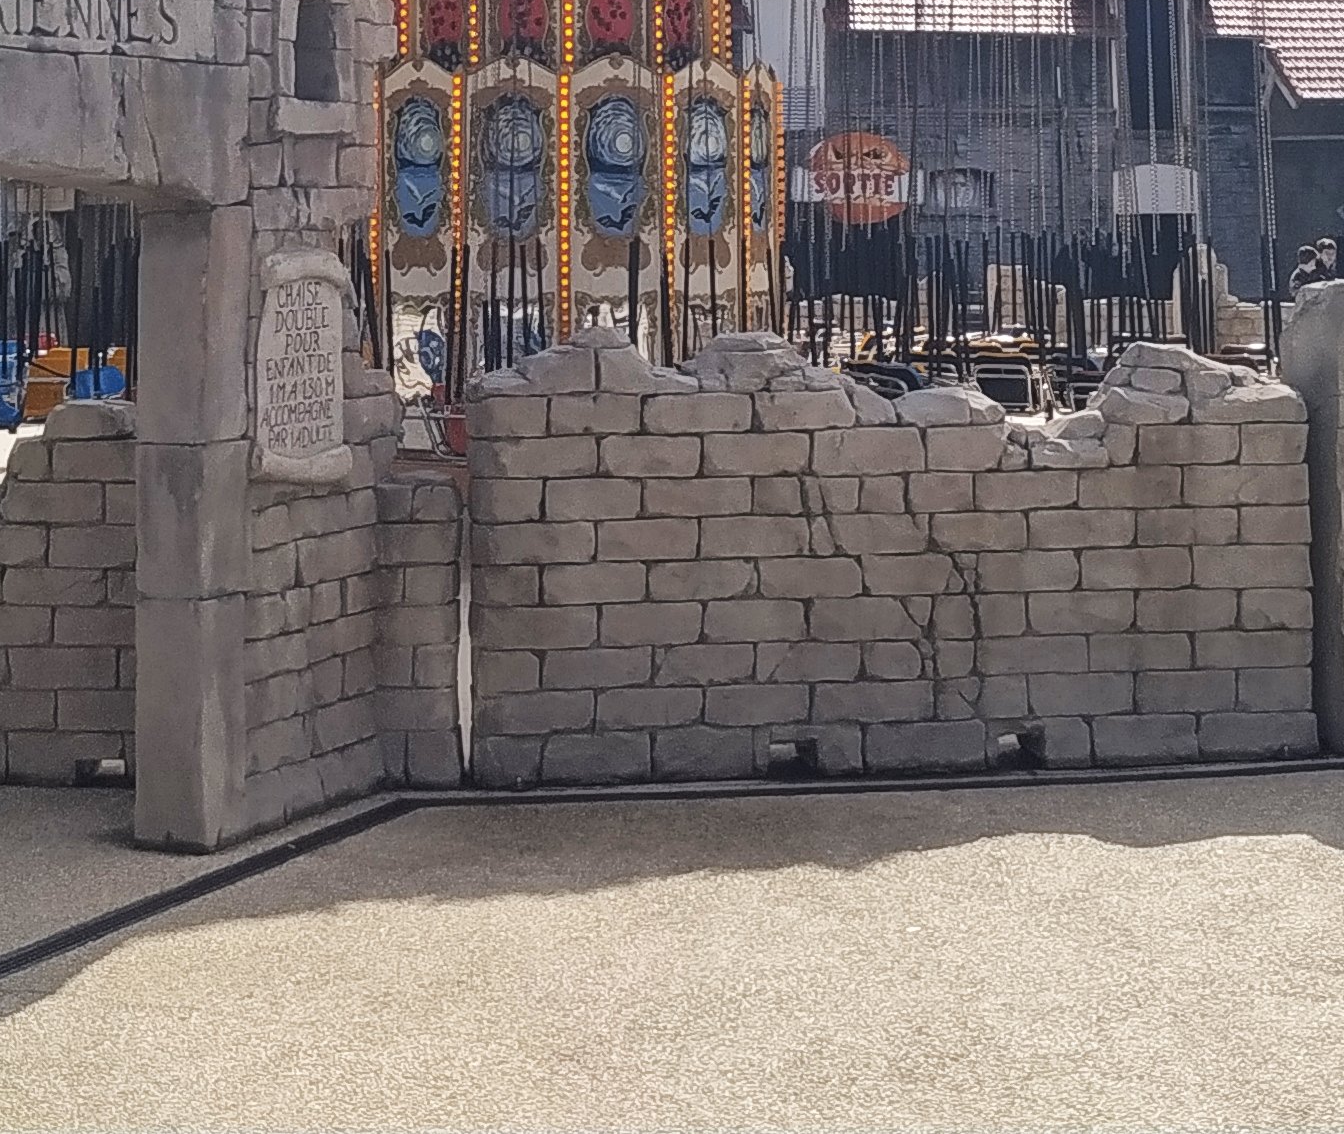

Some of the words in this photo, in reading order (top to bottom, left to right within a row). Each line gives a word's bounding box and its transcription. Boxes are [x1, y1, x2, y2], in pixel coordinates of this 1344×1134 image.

[814, 168, 895, 197] SORTIE
[276, 281, 322, 308] CHAISE
[274, 306, 329, 334] DOUBLE
[284, 331, 320, 355] POUR
[266, 356, 315, 381] ENFANT
[317, 352, 334, 373] DE
[276, 383, 286, 403] M
[287, 380, 297, 401] A
[325, 377, 335, 396] M
[260, 398, 334, 428] ACCOMPAGNE
[269, 427, 287, 448] PAR
